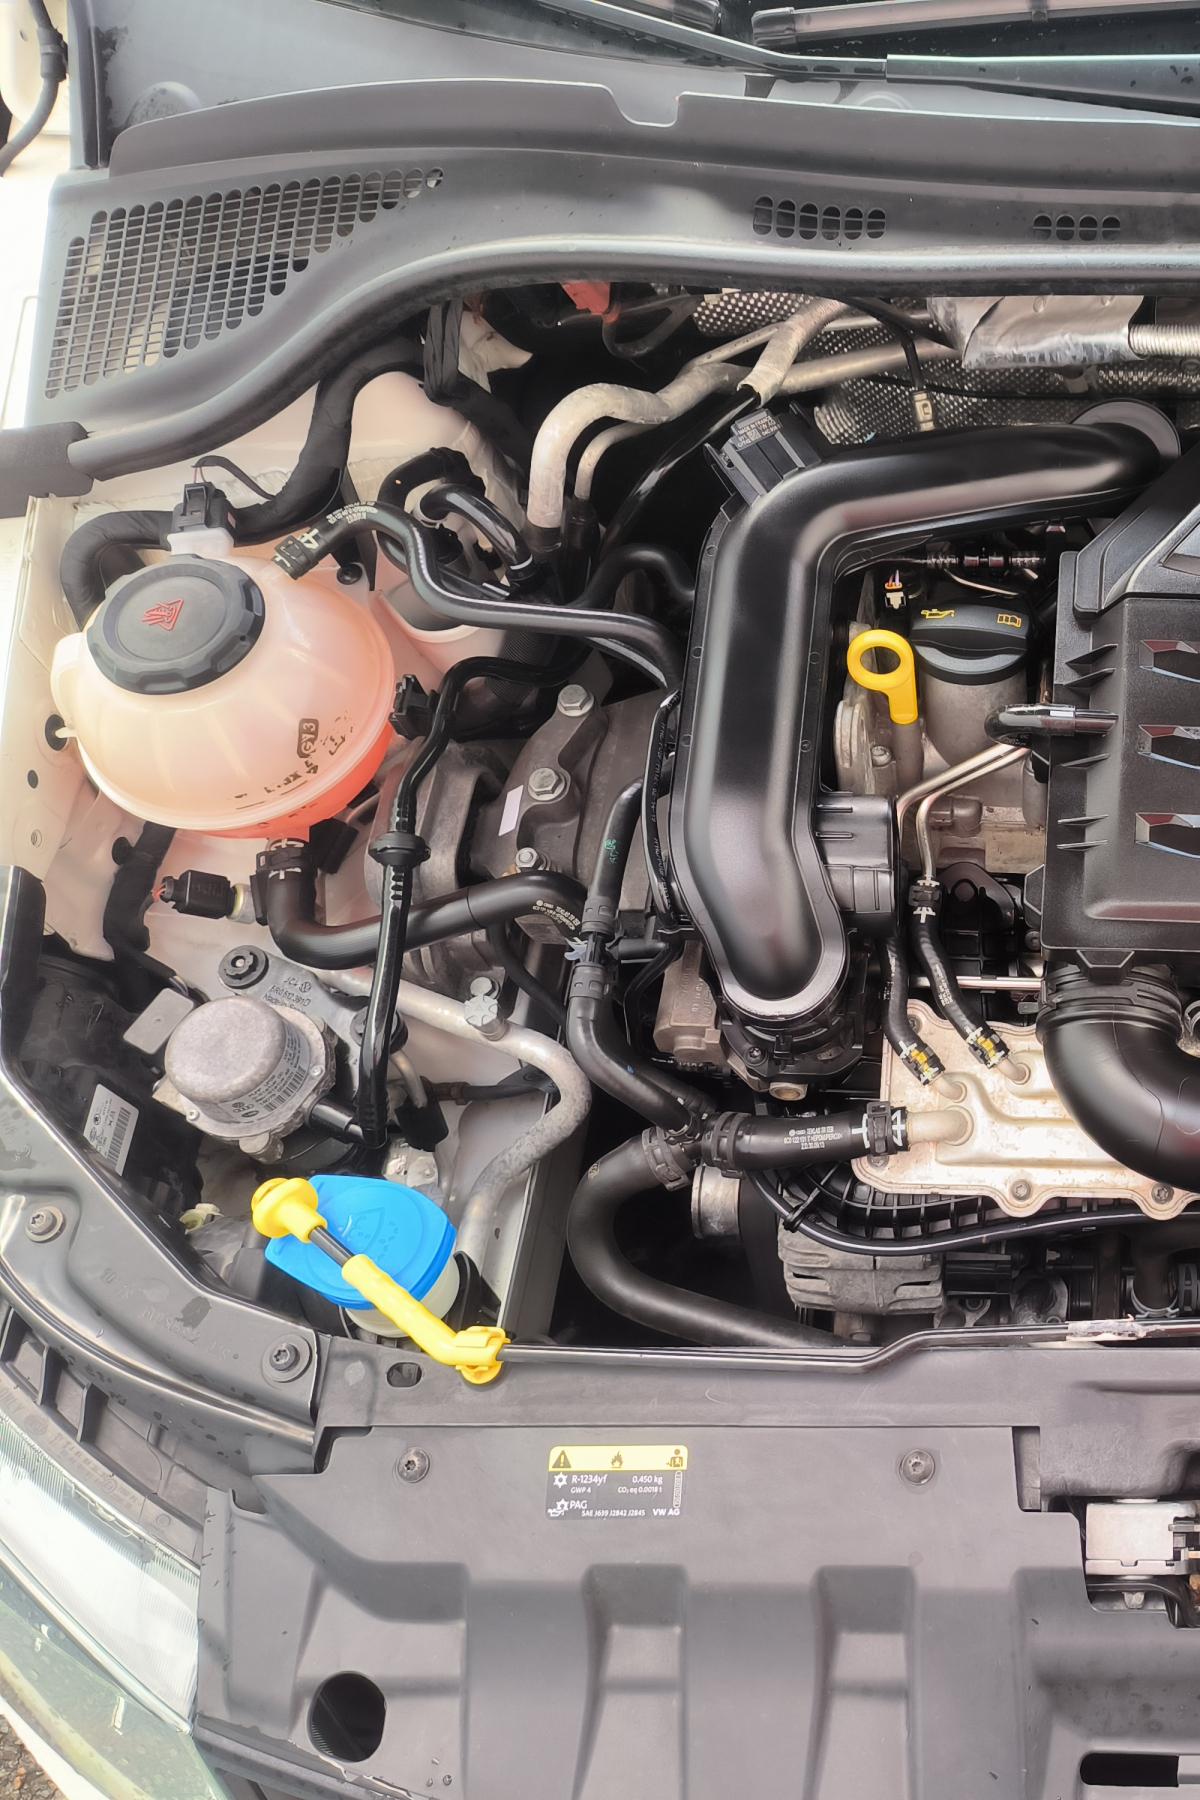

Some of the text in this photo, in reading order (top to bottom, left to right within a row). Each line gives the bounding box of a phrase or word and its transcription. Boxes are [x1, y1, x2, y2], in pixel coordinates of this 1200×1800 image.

[570, 1474, 608, 1486] R-1234yf
[653, 1475, 663, 1485] kg
[570, 1486, 587, 1494] GWP
[629, 1486, 638, 1495] eq
[569, 1500, 588, 1509] PAG
[581, 1509, 593, 1517] SAE
[652, 1508, 681, 1516] VW AG
